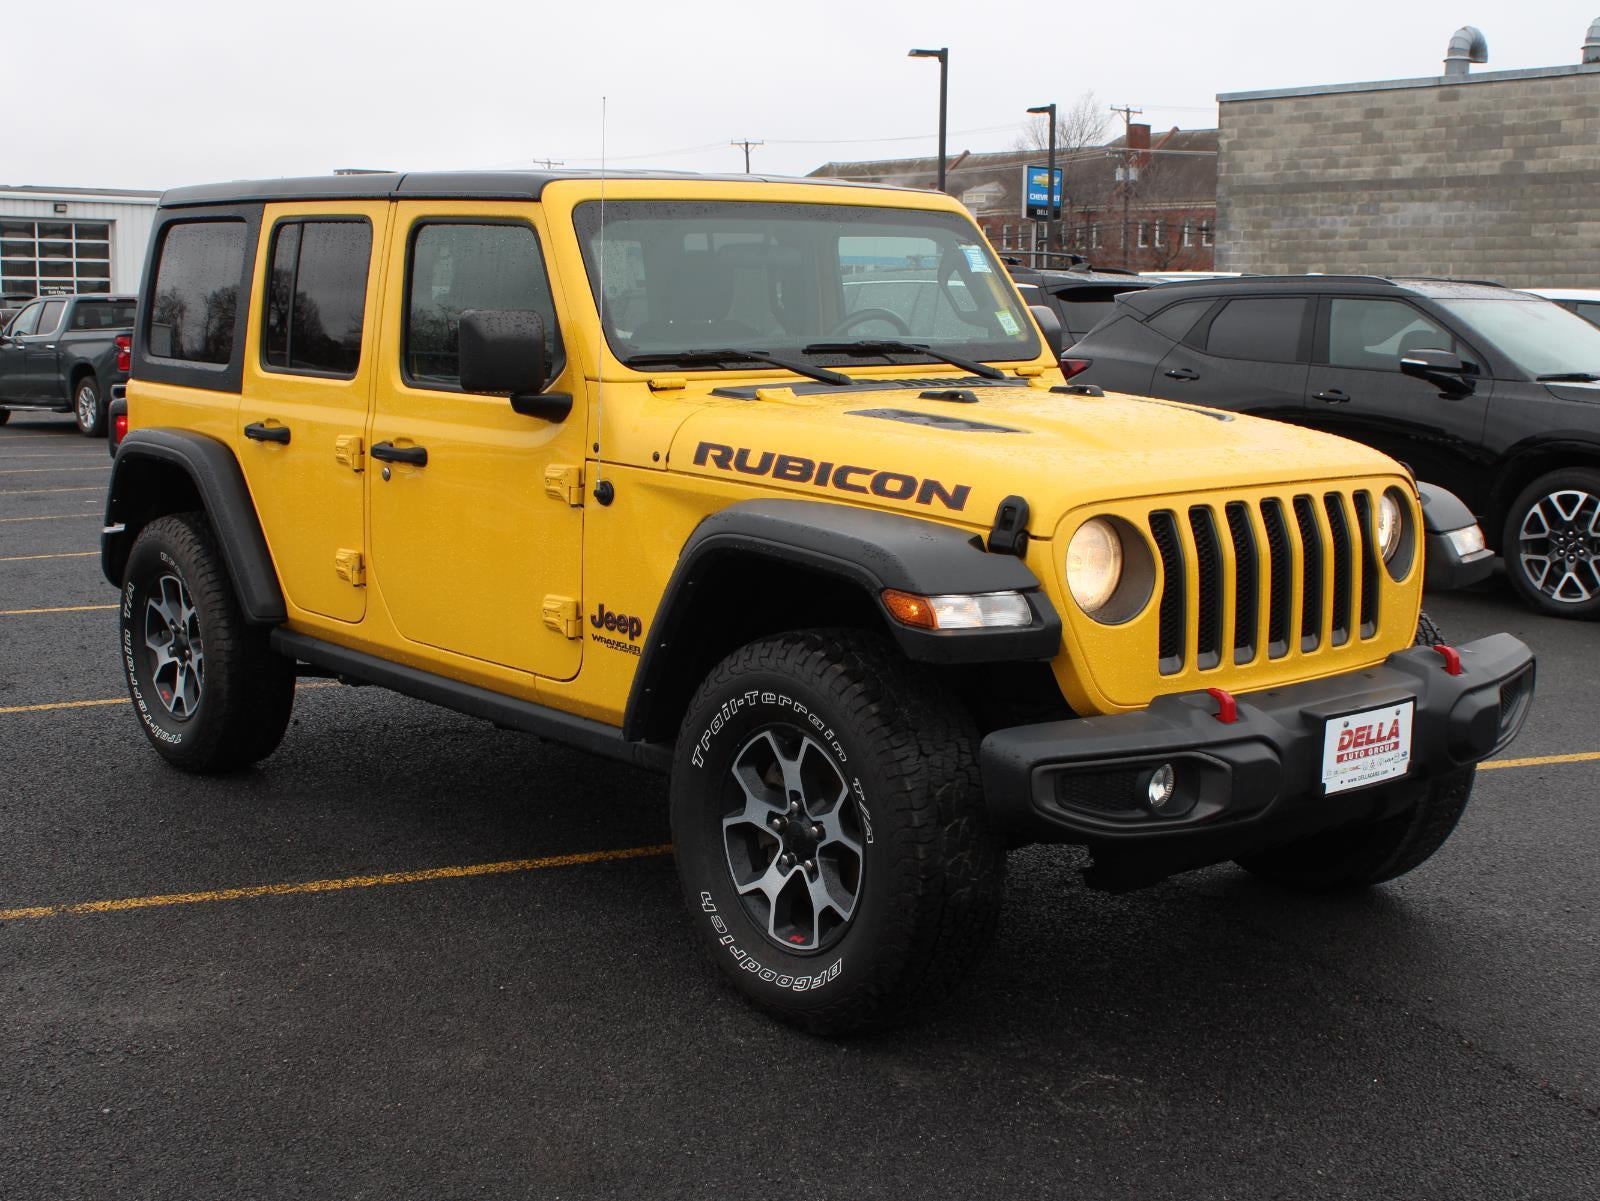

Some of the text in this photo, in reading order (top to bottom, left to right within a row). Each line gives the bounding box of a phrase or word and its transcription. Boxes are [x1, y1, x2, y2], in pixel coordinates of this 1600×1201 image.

[1029, 193, 1060, 201] CHEVRET
[692, 441, 972, 512] RUBICON
[590, 603, 642, 641] Jeep
[591, 633, 641, 654] WRANGLER
[692, 690, 848, 768] Trail-Terrain
[1337, 719, 1399, 751] DELLA
[1343, 743, 1395, 761] AUTO GROUP
[852, 777, 874, 844] T/A
[700, 891, 842, 992] BFGoodrich
